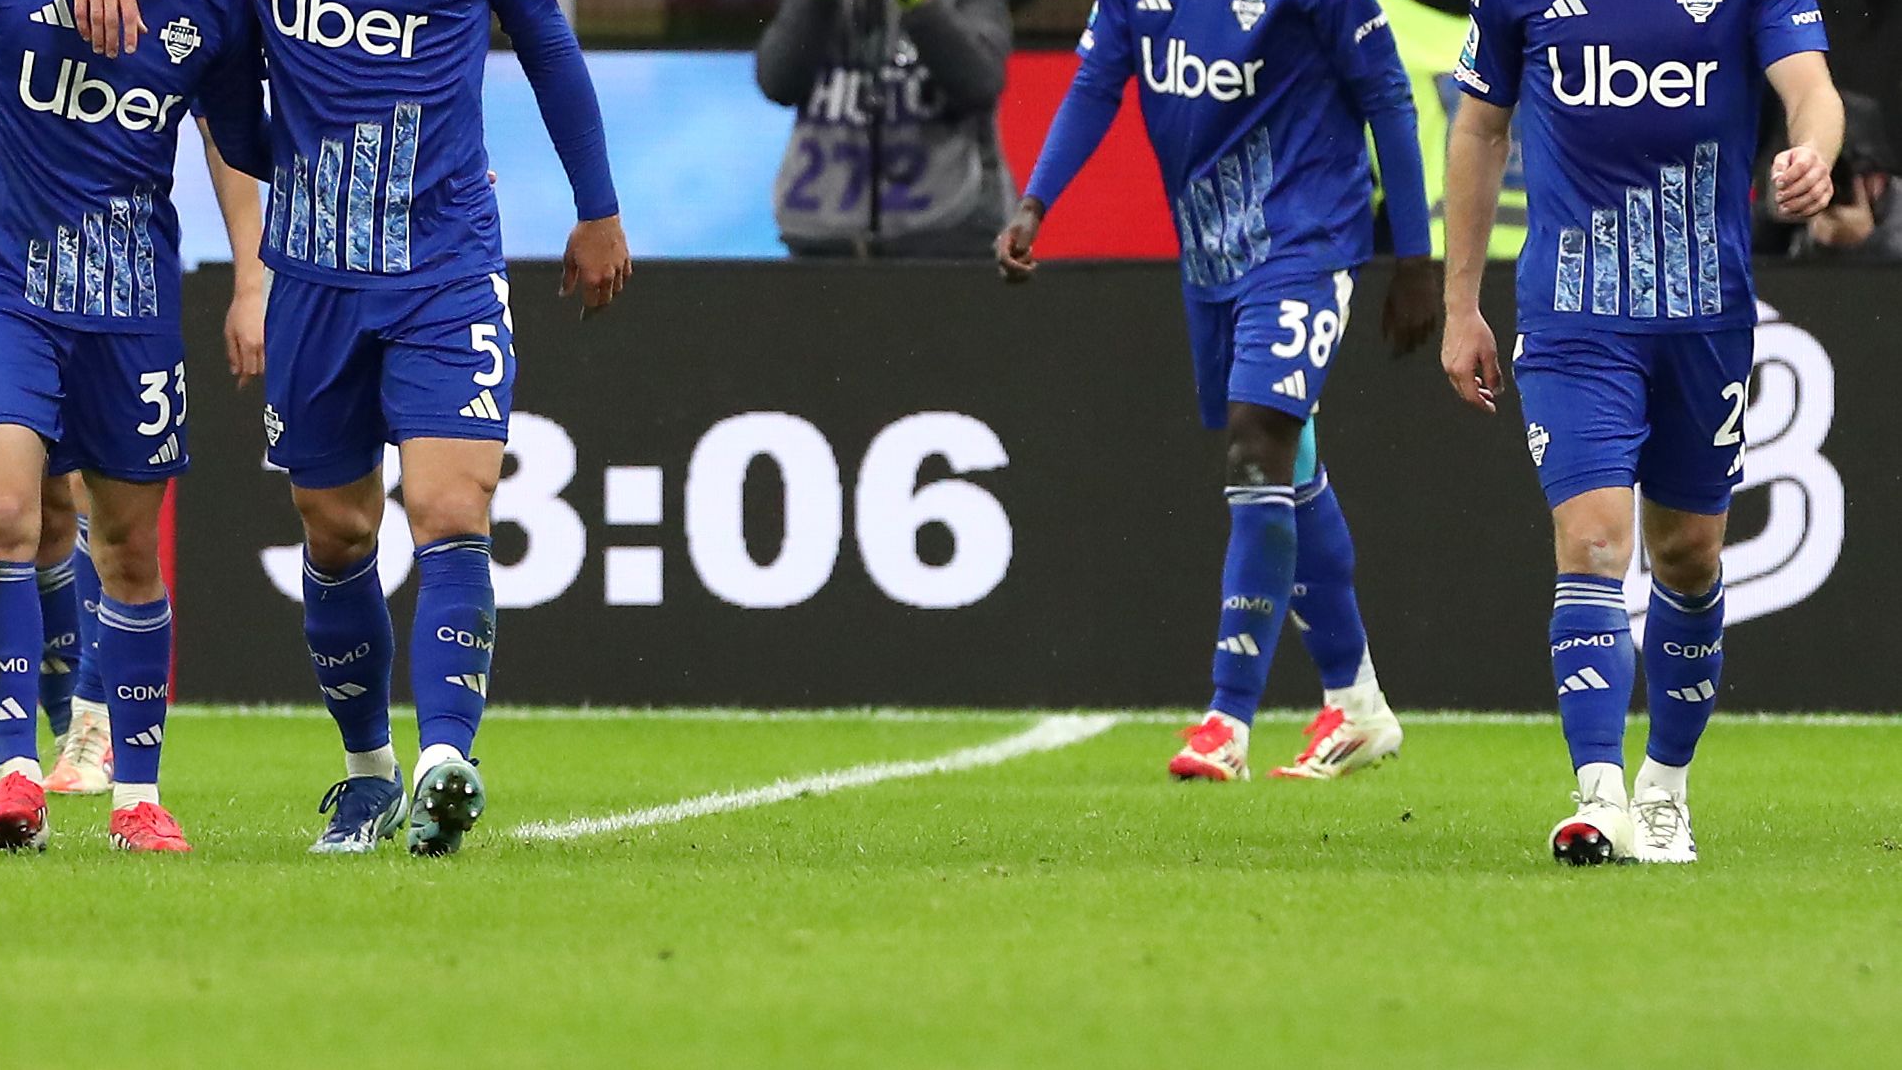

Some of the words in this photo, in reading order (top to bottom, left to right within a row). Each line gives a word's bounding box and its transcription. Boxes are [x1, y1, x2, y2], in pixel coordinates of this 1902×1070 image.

[168, 30, 194, 46] COMO
[1141, 35, 1265, 102] Uber
[19, 49, 184, 133] Uber
[1547, 45, 1719, 108] Uber
[784, 137, 934, 213] 272
[470, 323, 504, 387] 5
[1270, 299, 1340, 369] 38
[137, 360, 187, 436] 33
[1713, 374, 1751, 447] 2
[436, 626, 494, 652] COM
[1663, 635, 1723, 660] COM
